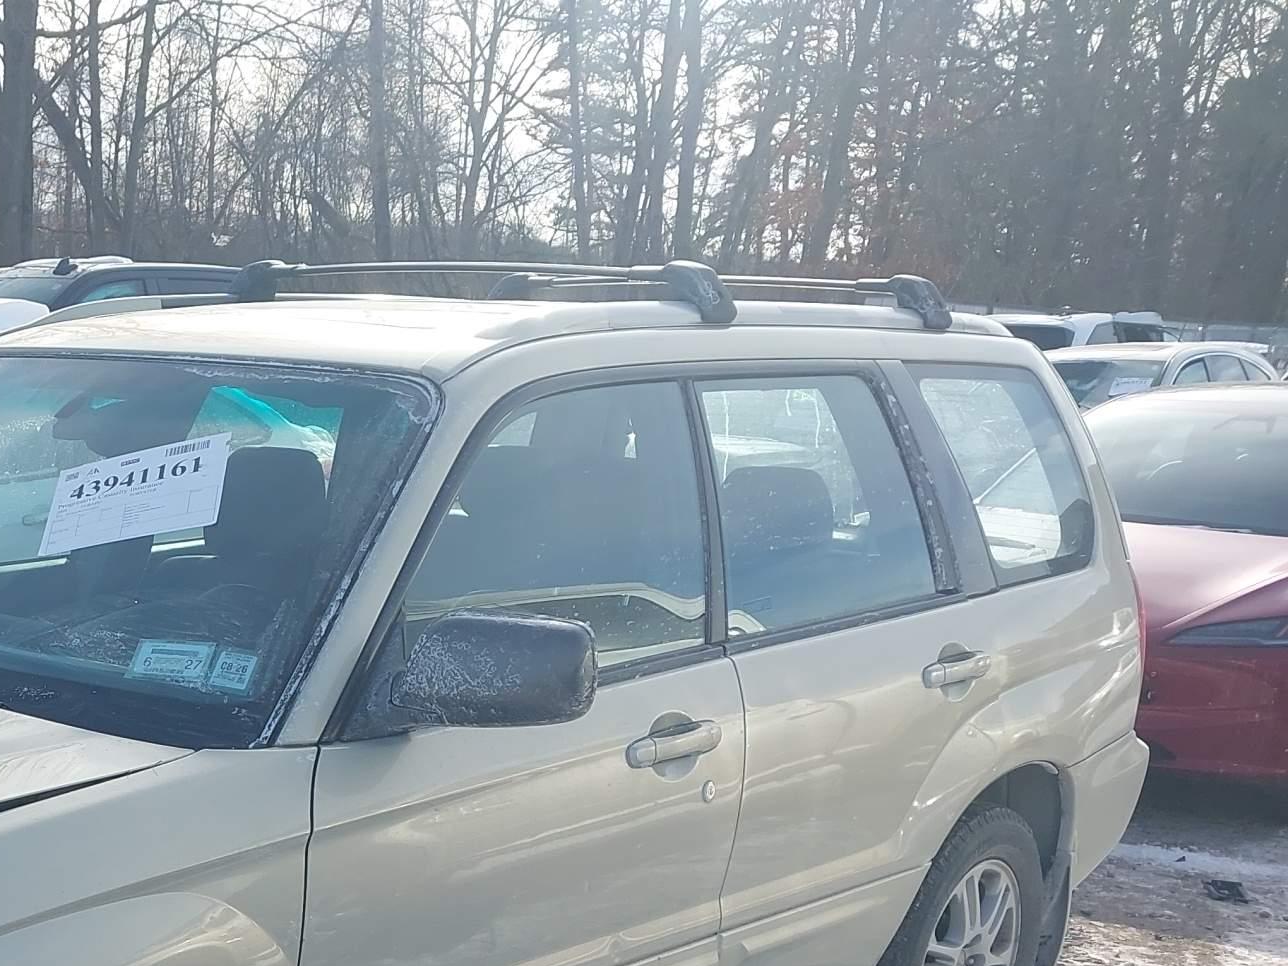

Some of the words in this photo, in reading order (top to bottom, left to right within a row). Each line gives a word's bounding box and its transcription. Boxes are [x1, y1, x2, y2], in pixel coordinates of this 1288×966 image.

[69, 456, 203, 499] 43941161
[143, 656, 153, 667] 6
[184, 659, 202, 671] 27
[235, 663, 249, 673] 26
